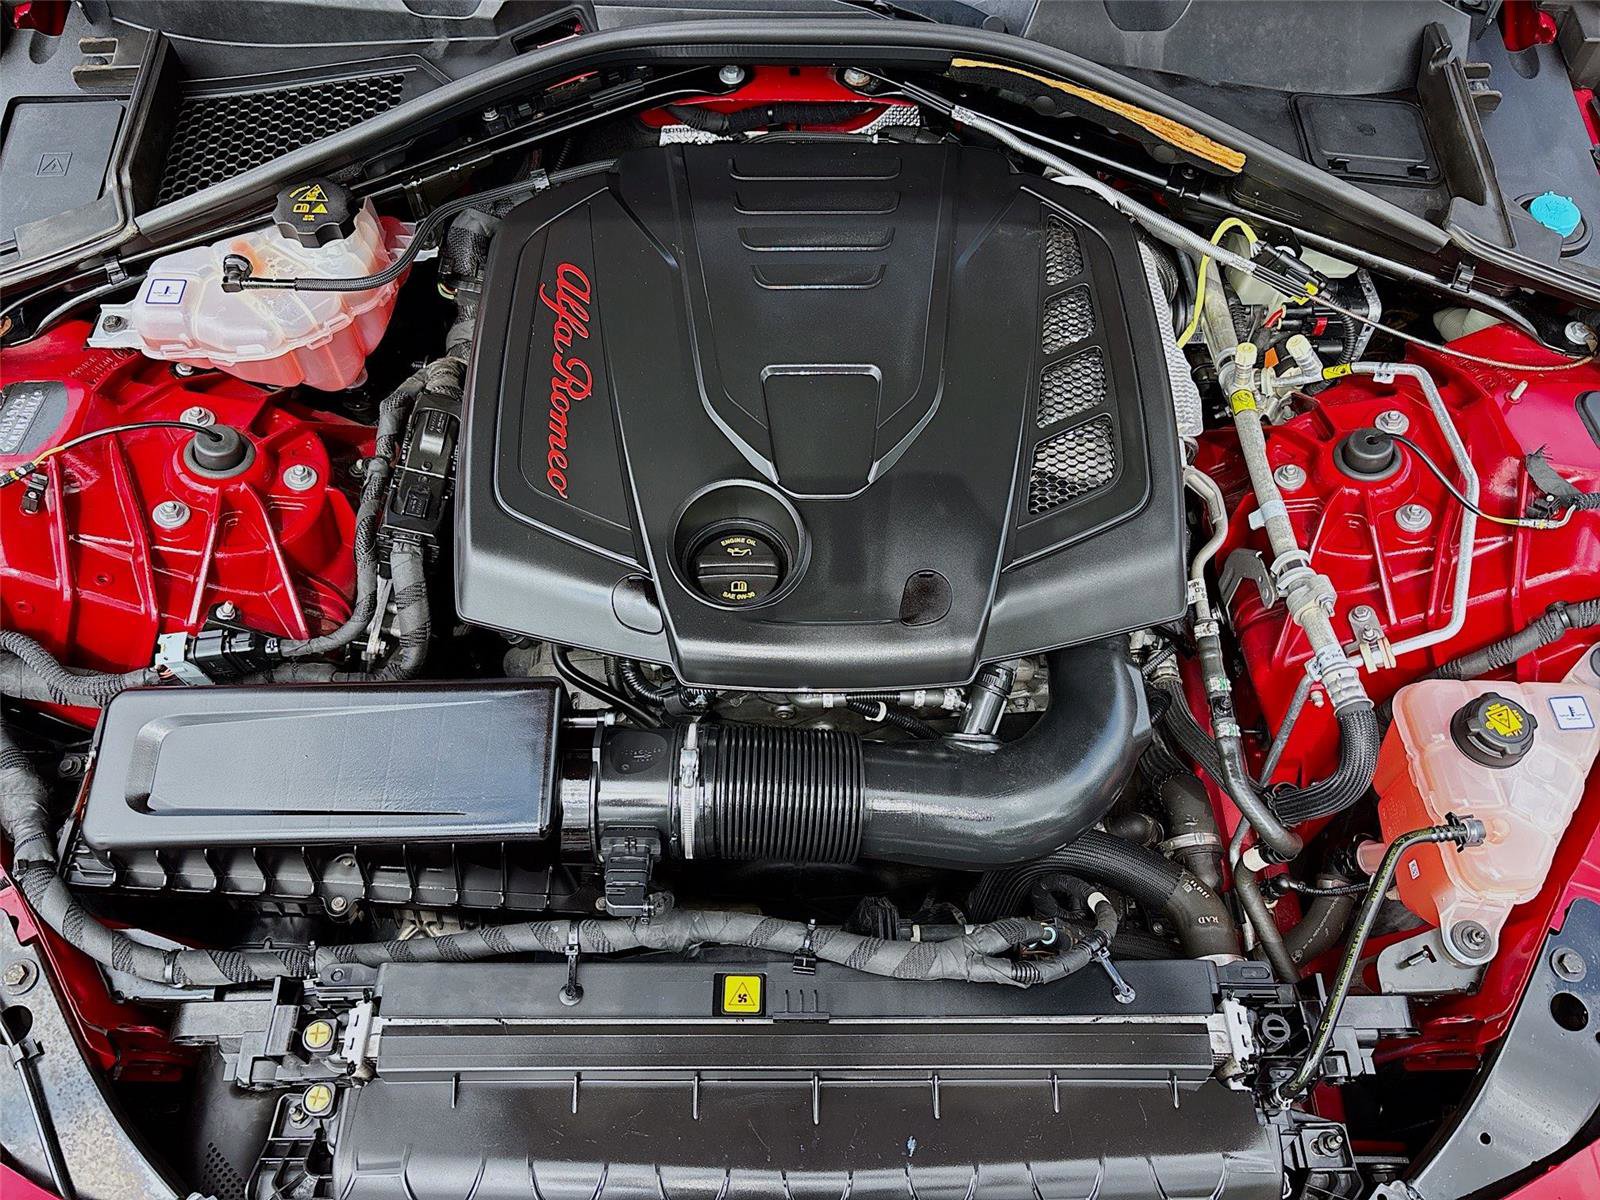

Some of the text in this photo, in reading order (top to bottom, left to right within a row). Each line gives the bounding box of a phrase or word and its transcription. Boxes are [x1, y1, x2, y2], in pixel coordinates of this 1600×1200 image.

[539, 263, 593, 499] Alfa Romeo
[720, 537, 756, 546] ENGINE OIL
[722, 591, 735, 599] SAE
[1198, 915, 1219, 924] RAD
